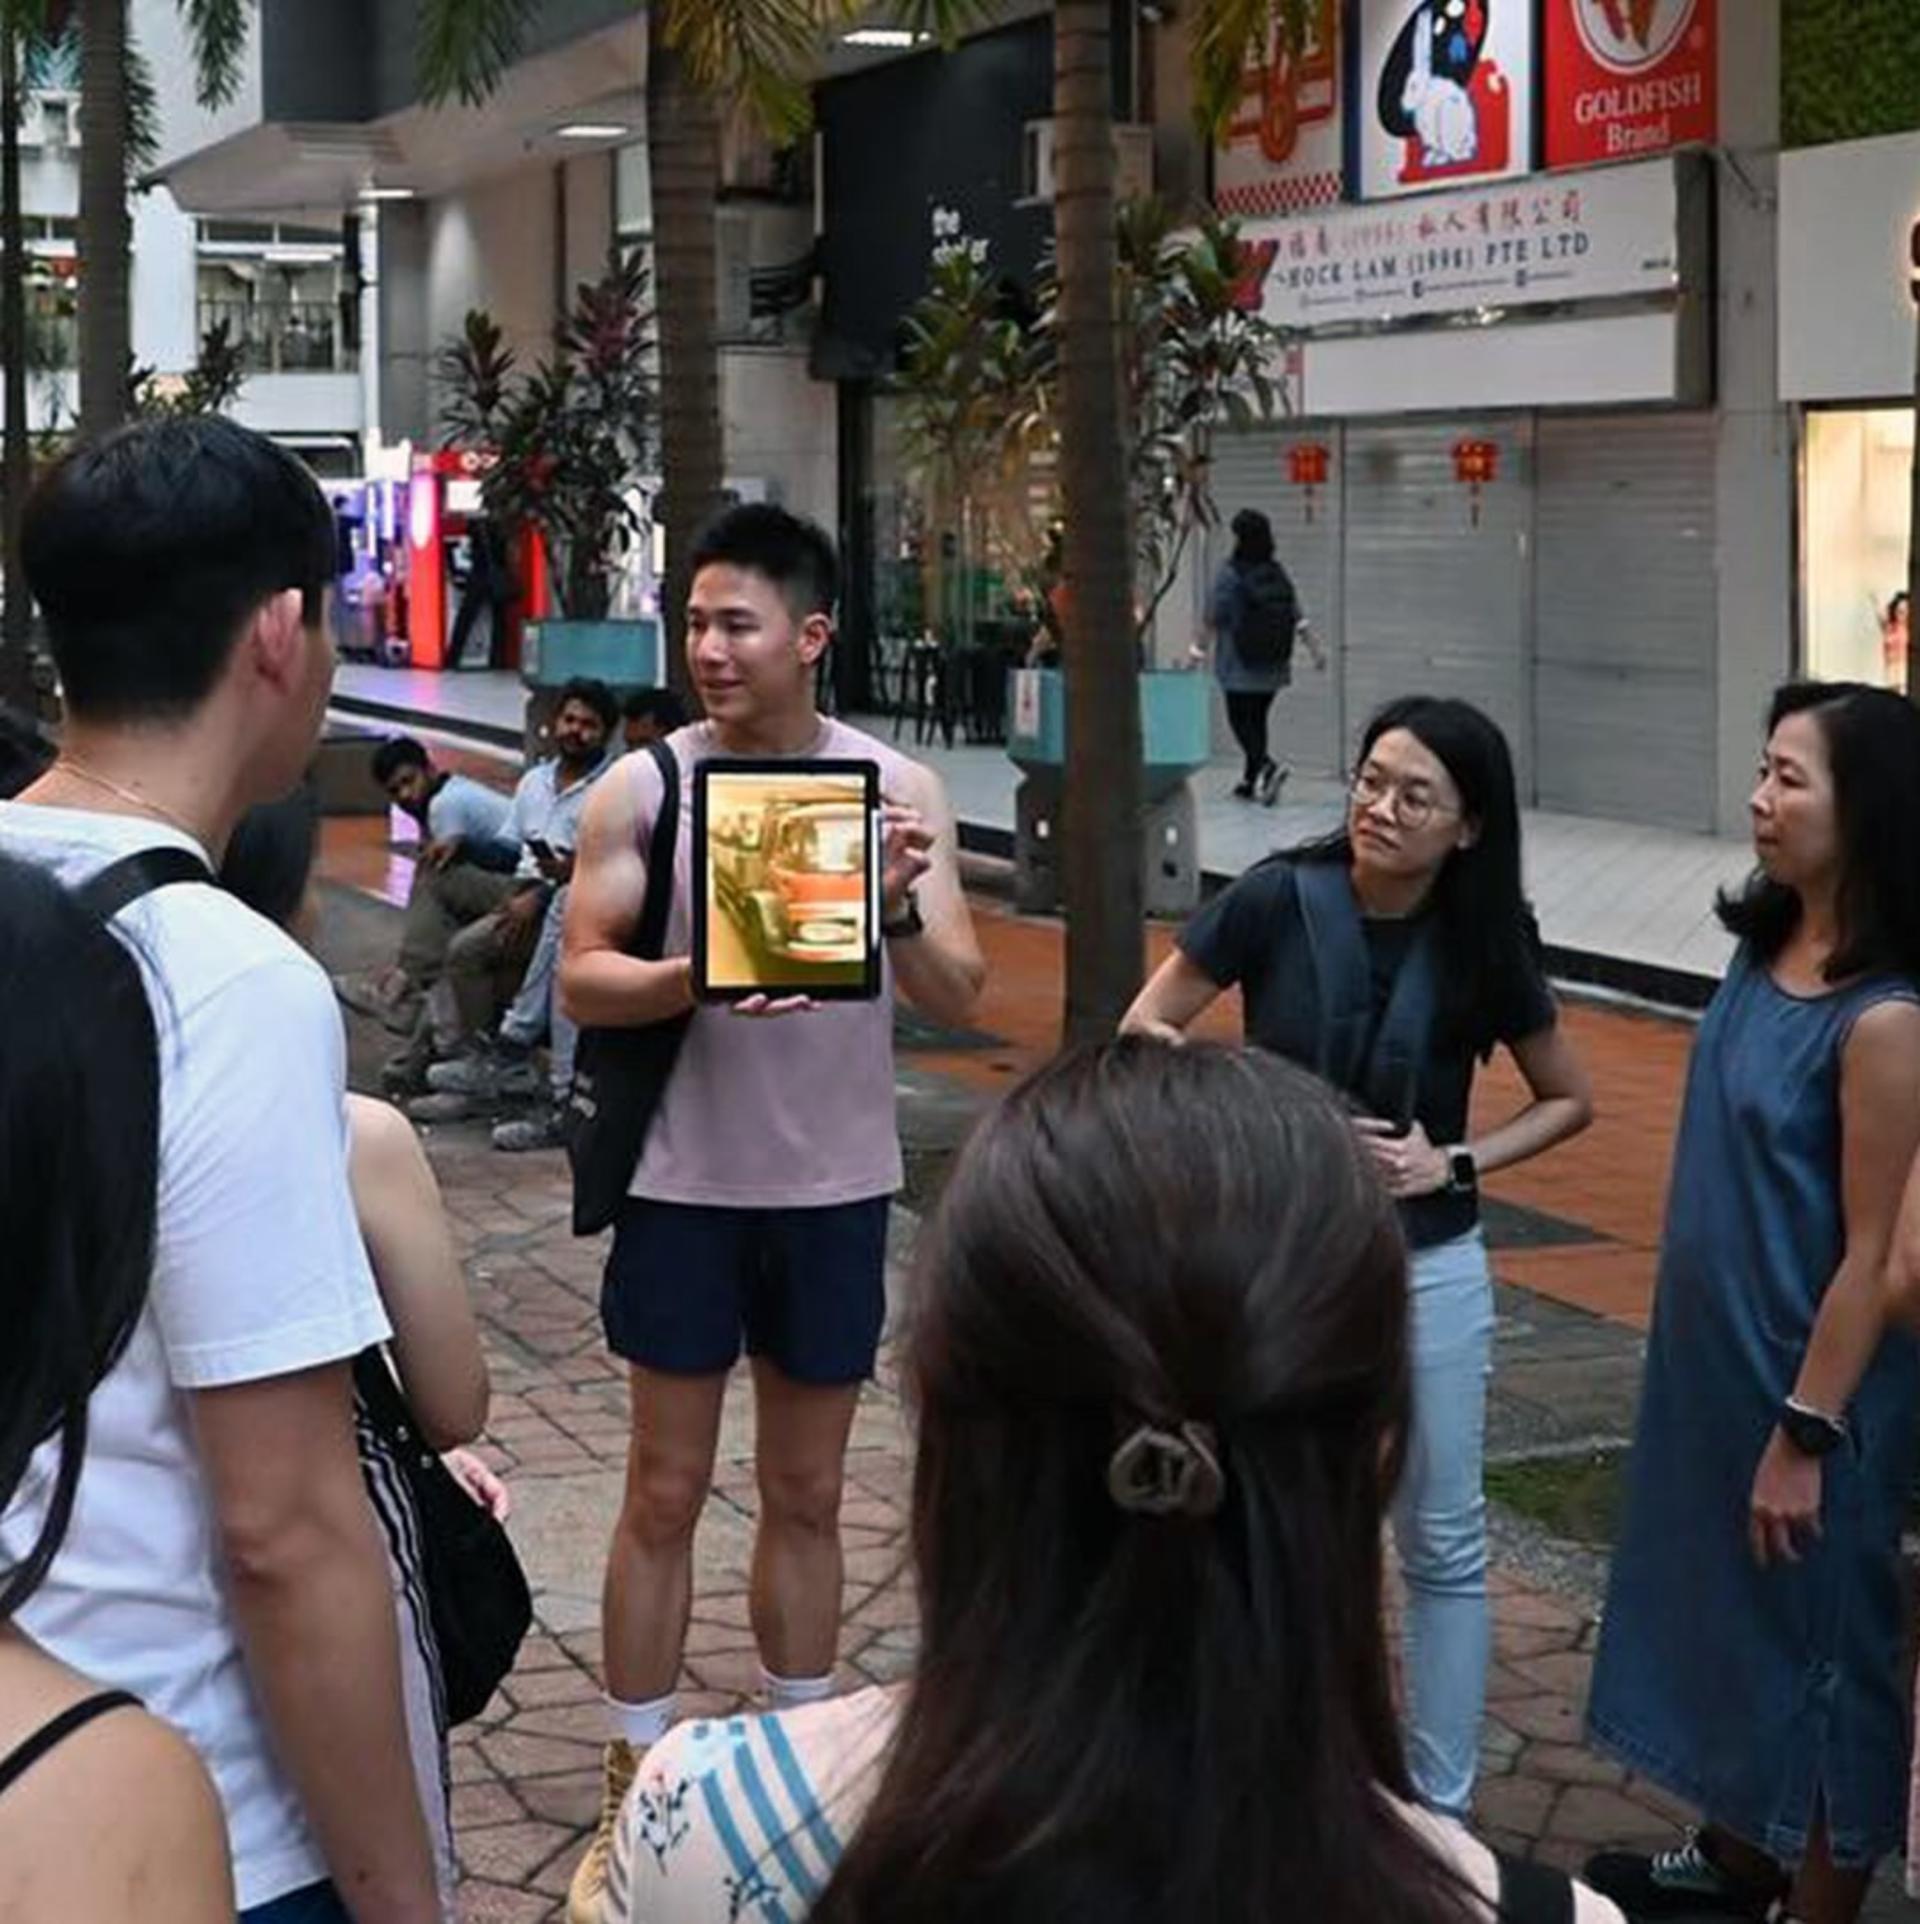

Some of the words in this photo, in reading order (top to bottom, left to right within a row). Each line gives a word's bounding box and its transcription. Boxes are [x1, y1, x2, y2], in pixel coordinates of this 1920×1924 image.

[1574, 73, 1700, 126] GOLDFISH
[1607, 111, 1670, 152] Brand
[1353, 256, 1396, 281] LAM
[1486, 240, 1528, 265] PTE
[1541, 231, 1590, 259] LTD
